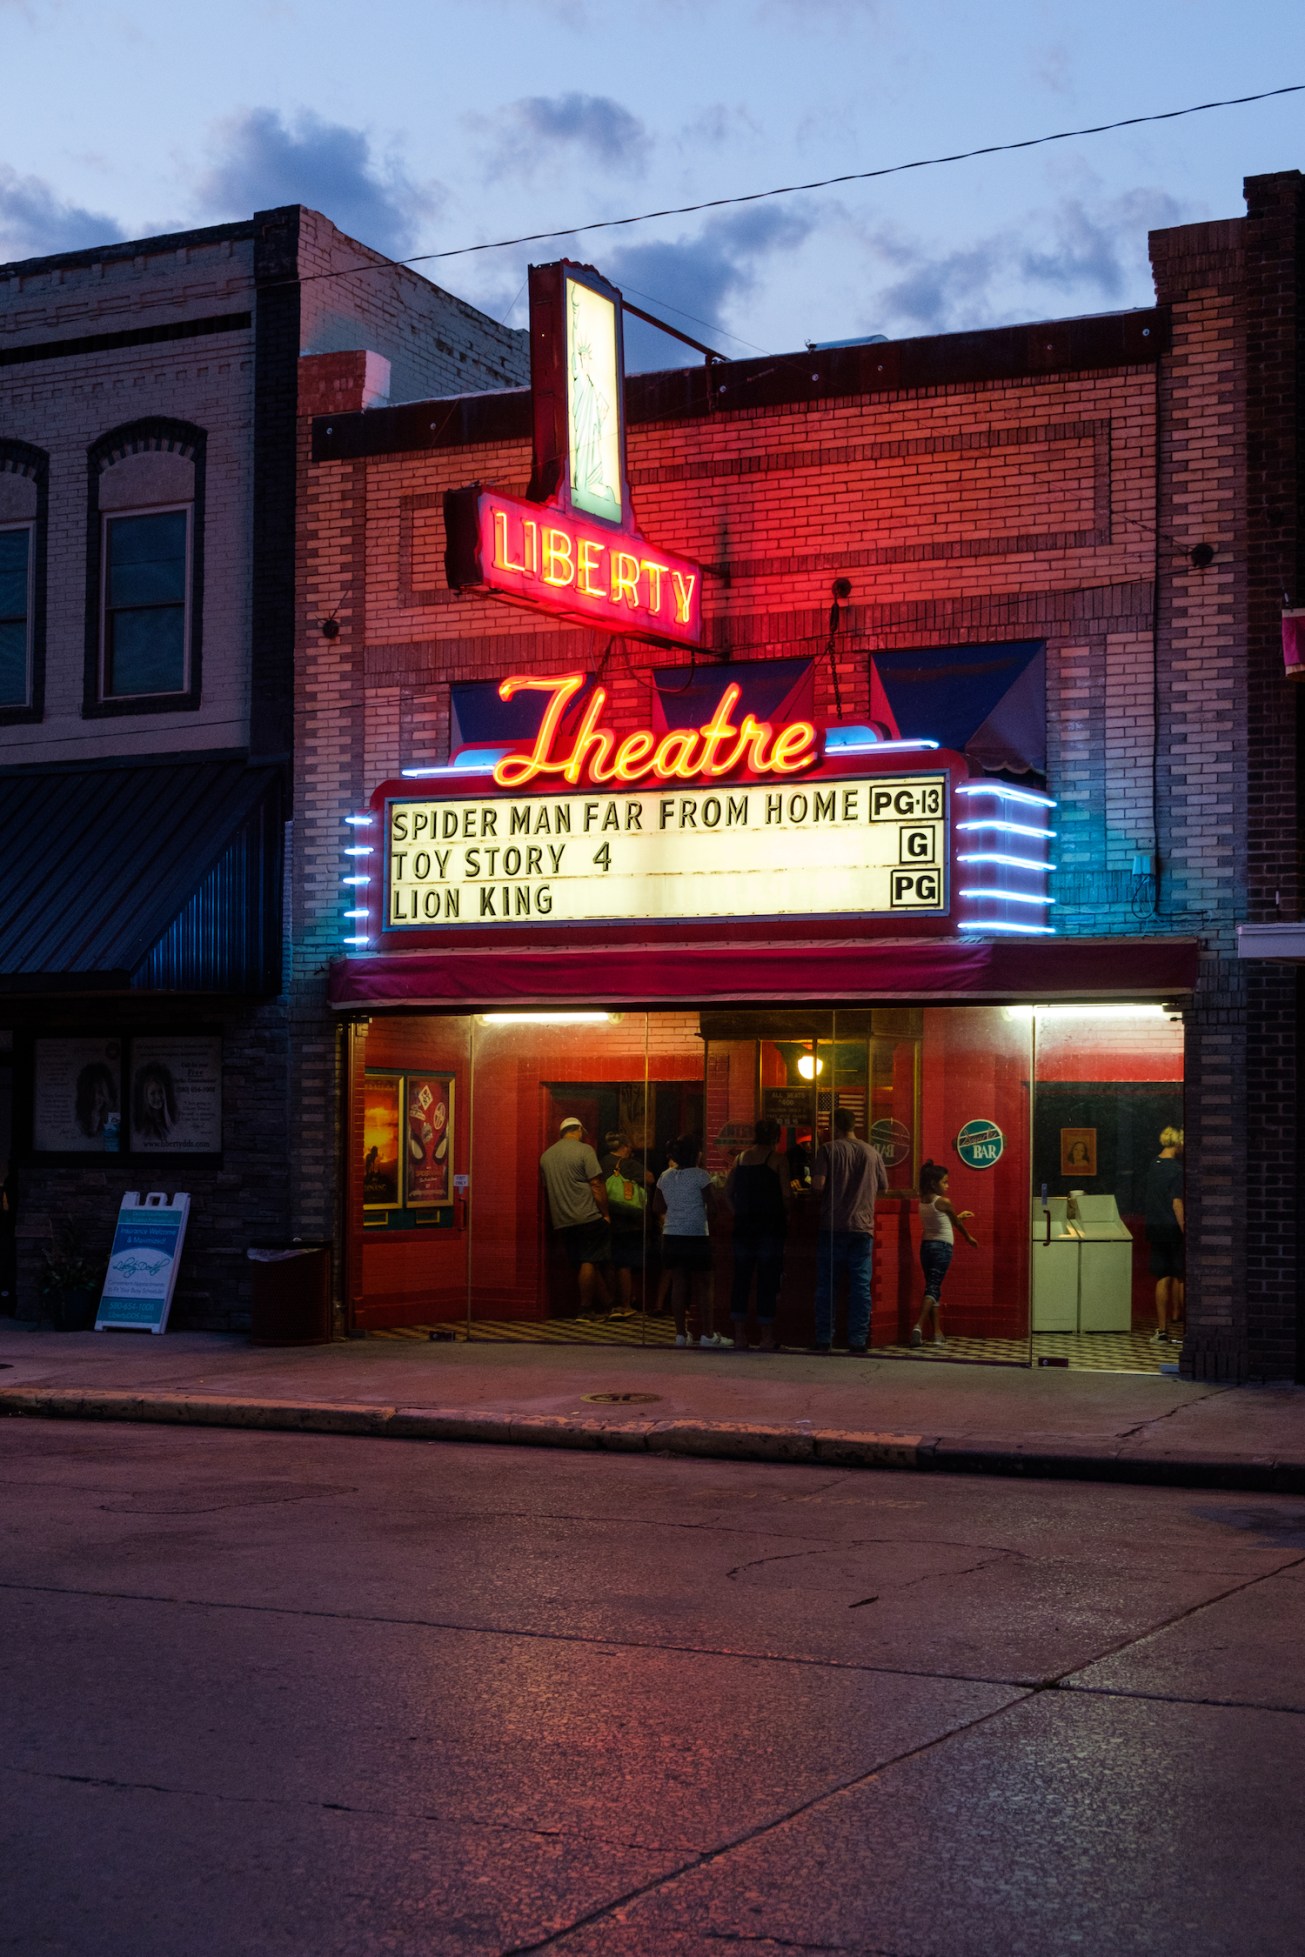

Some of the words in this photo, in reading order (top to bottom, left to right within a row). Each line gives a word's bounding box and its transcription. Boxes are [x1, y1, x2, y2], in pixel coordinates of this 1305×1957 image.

[491, 506, 695, 625] LIBERTY
[493, 671, 816, 787] Theatre
[392, 808, 498, 841] SPIDER
[509, 803, 571, 835] MAN
[583, 800, 643, 832] FAR
[659, 795, 749, 829] FROM
[764, 789, 859, 824] HOME
[392, 848, 452, 880] TOY
[464, 843, 566, 877] STORY
[592, 841, 612, 872] 4
[907, 832, 928, 857] G
[393, 888, 460, 919] LION
[479, 884, 553, 916] KING
[894, 875, 937, 901] PG
[973, 1144, 997, 1159] BAR
